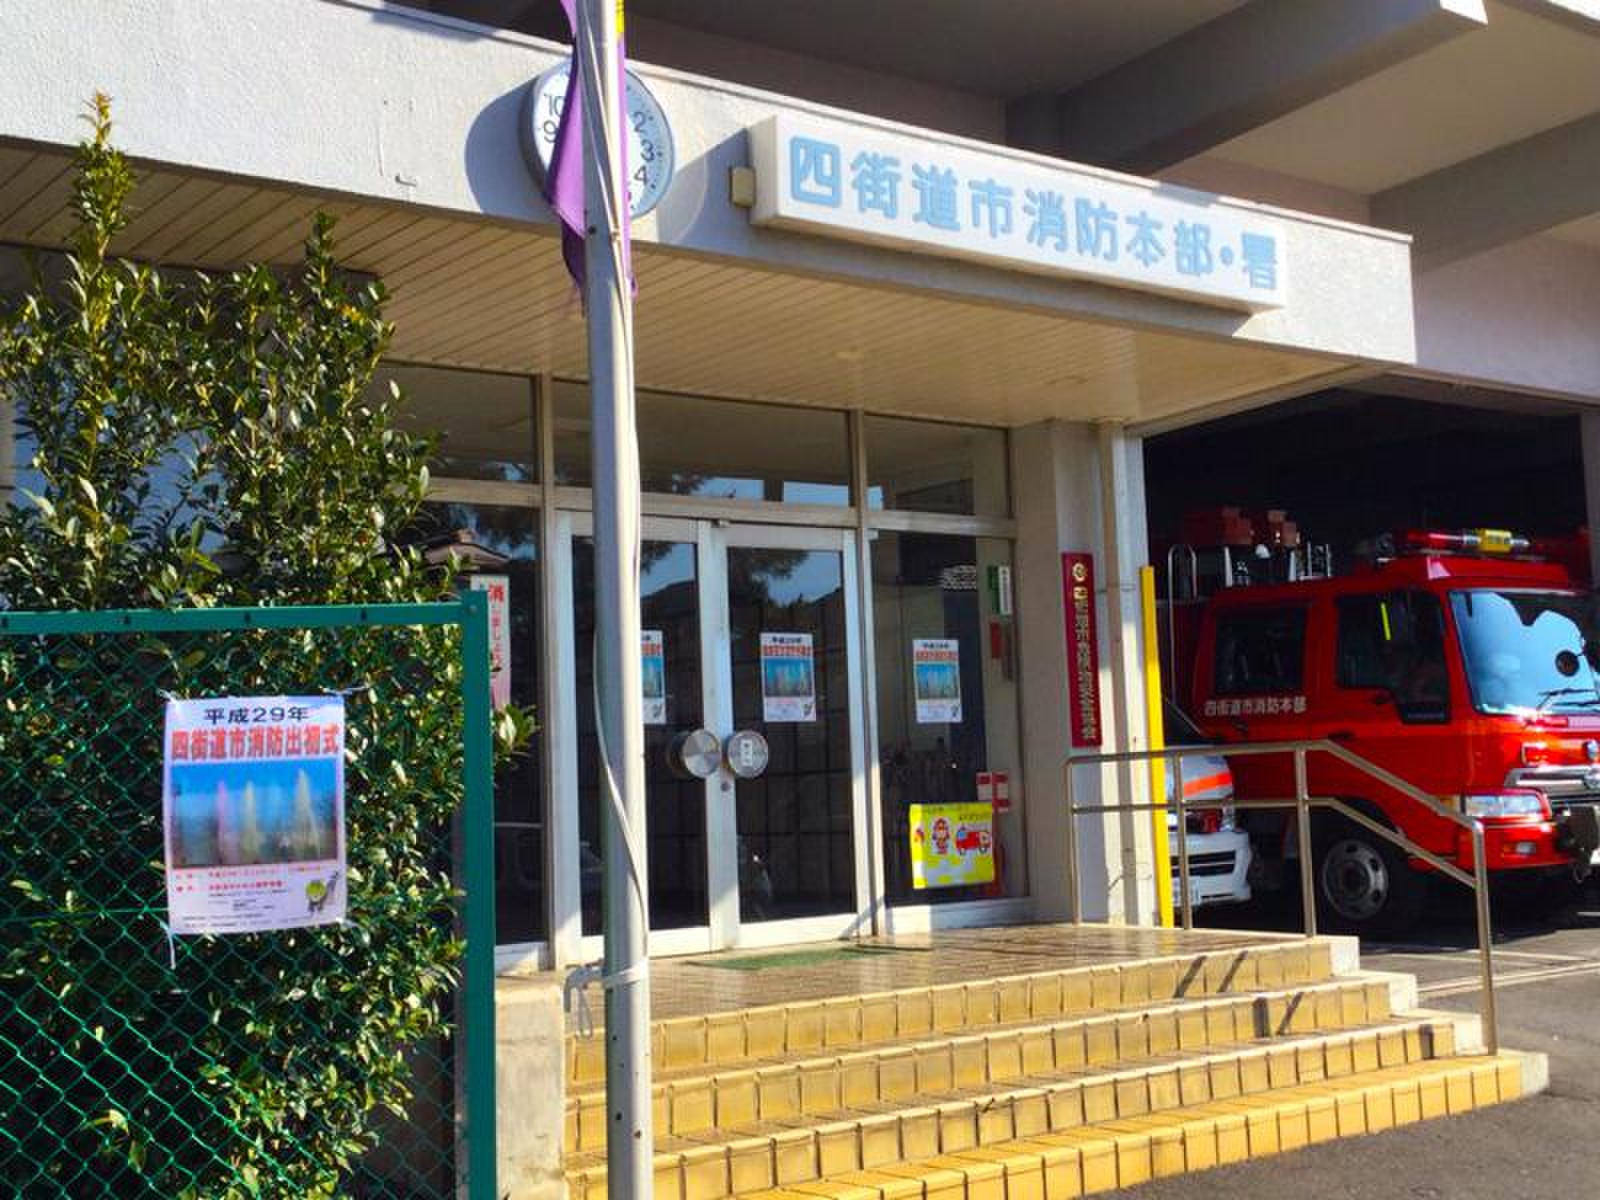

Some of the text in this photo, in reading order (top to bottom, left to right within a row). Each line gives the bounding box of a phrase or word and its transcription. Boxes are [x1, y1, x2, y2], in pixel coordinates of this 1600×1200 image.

[633, 111, 648, 133] 2
[640, 139, 655, 162] 3
[633, 165, 648, 186] 4
[789, 135, 1278, 291] 四街道市消防本部・署
[204, 705, 310, 725] 平成29年
[171, 723, 340, 761] 四街道市消防出初式
